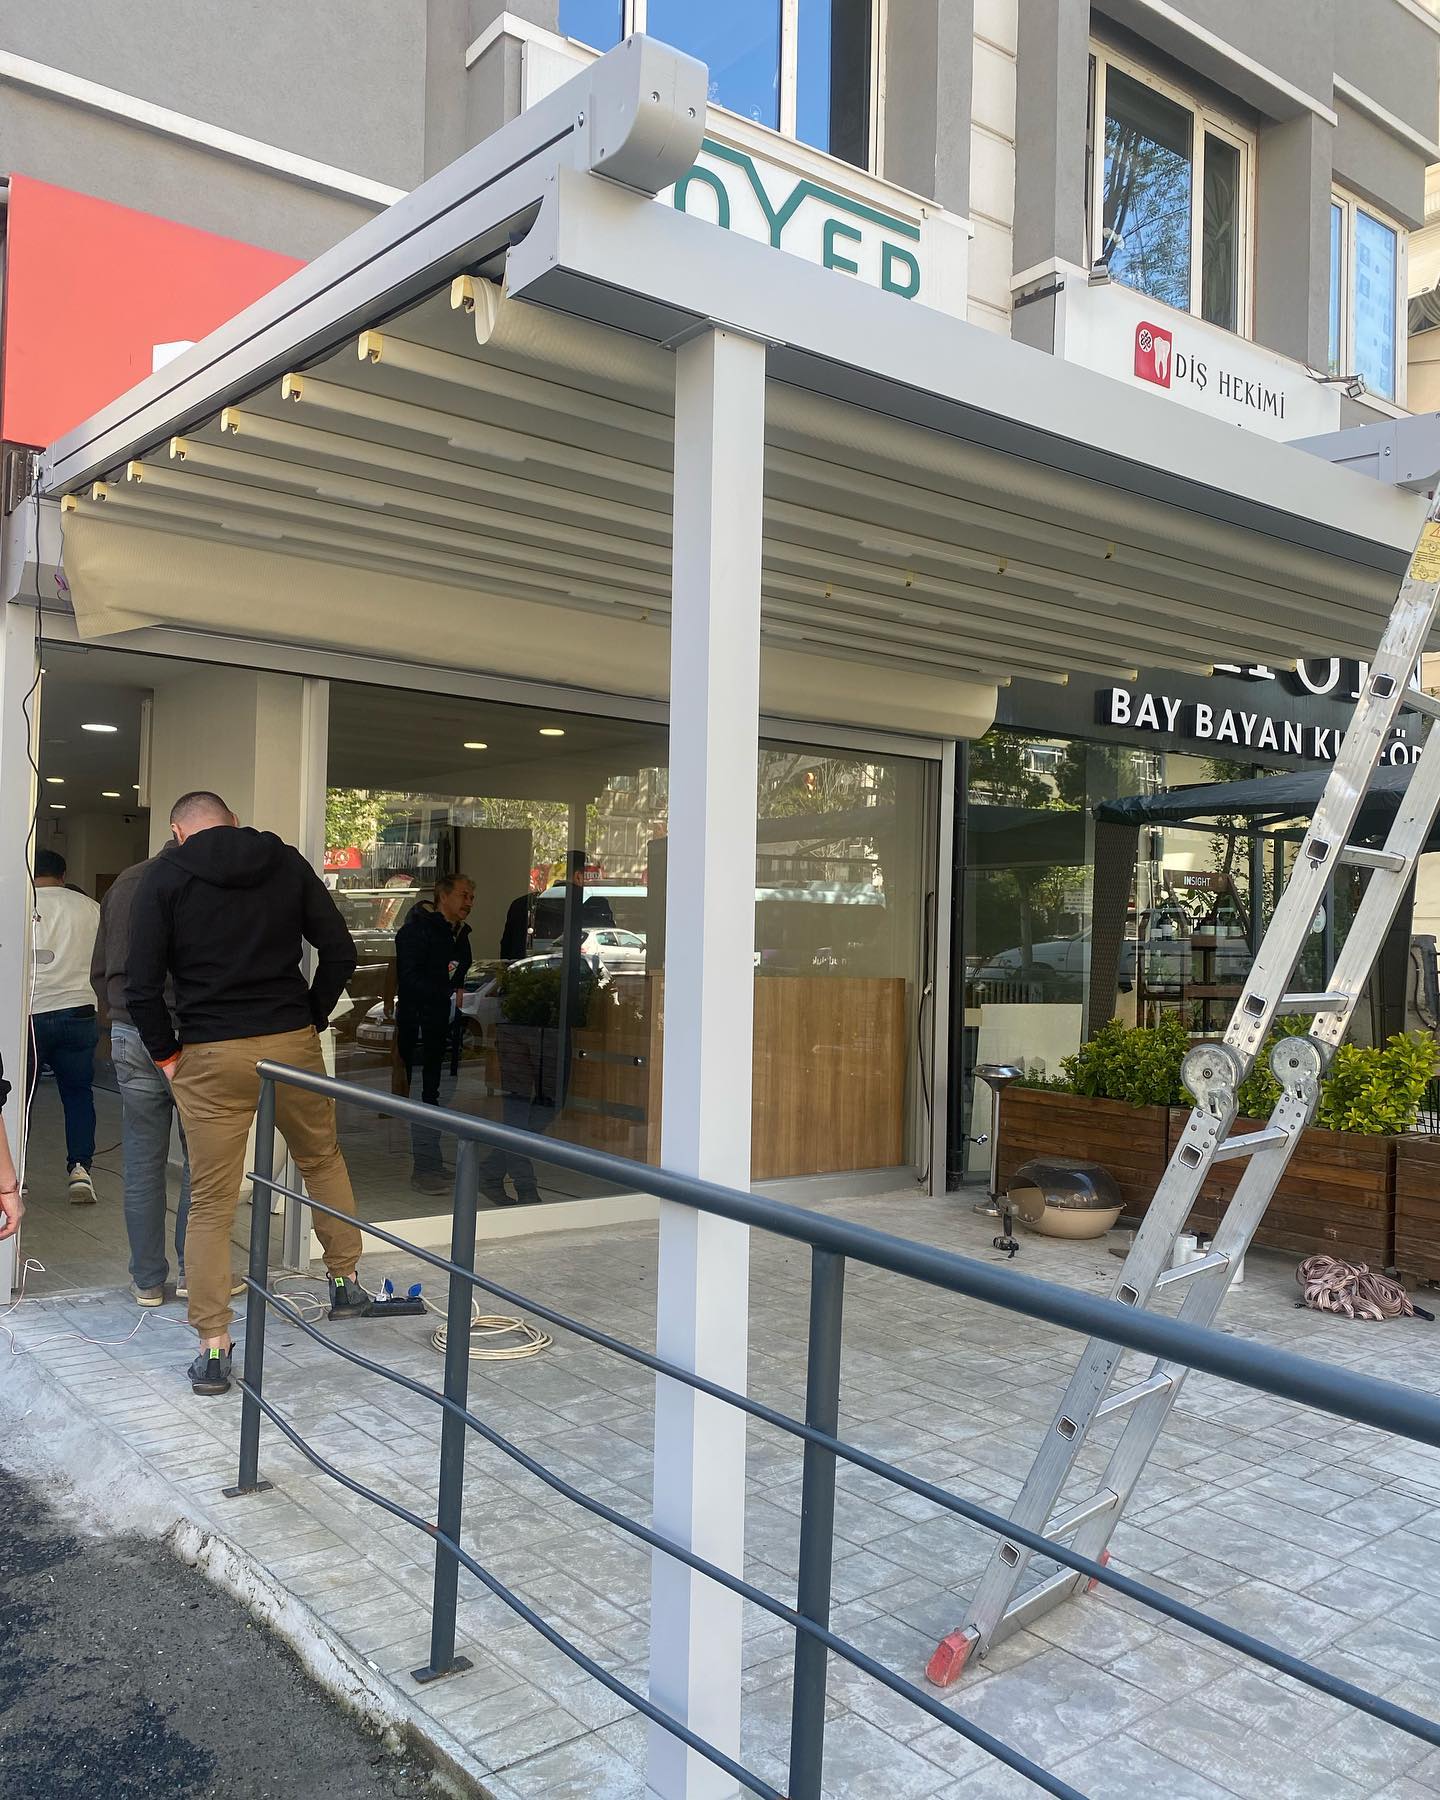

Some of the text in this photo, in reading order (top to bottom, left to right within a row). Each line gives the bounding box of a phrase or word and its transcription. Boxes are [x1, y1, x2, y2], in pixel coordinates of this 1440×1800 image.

[1175, 352, 1287, 420] DİŞ HEKİMİ
[1110, 687, 1183, 733] BAY
[1195, 703, 1303, 755] BAYAN
[1183, 875, 1211, 887] INSIGHT
